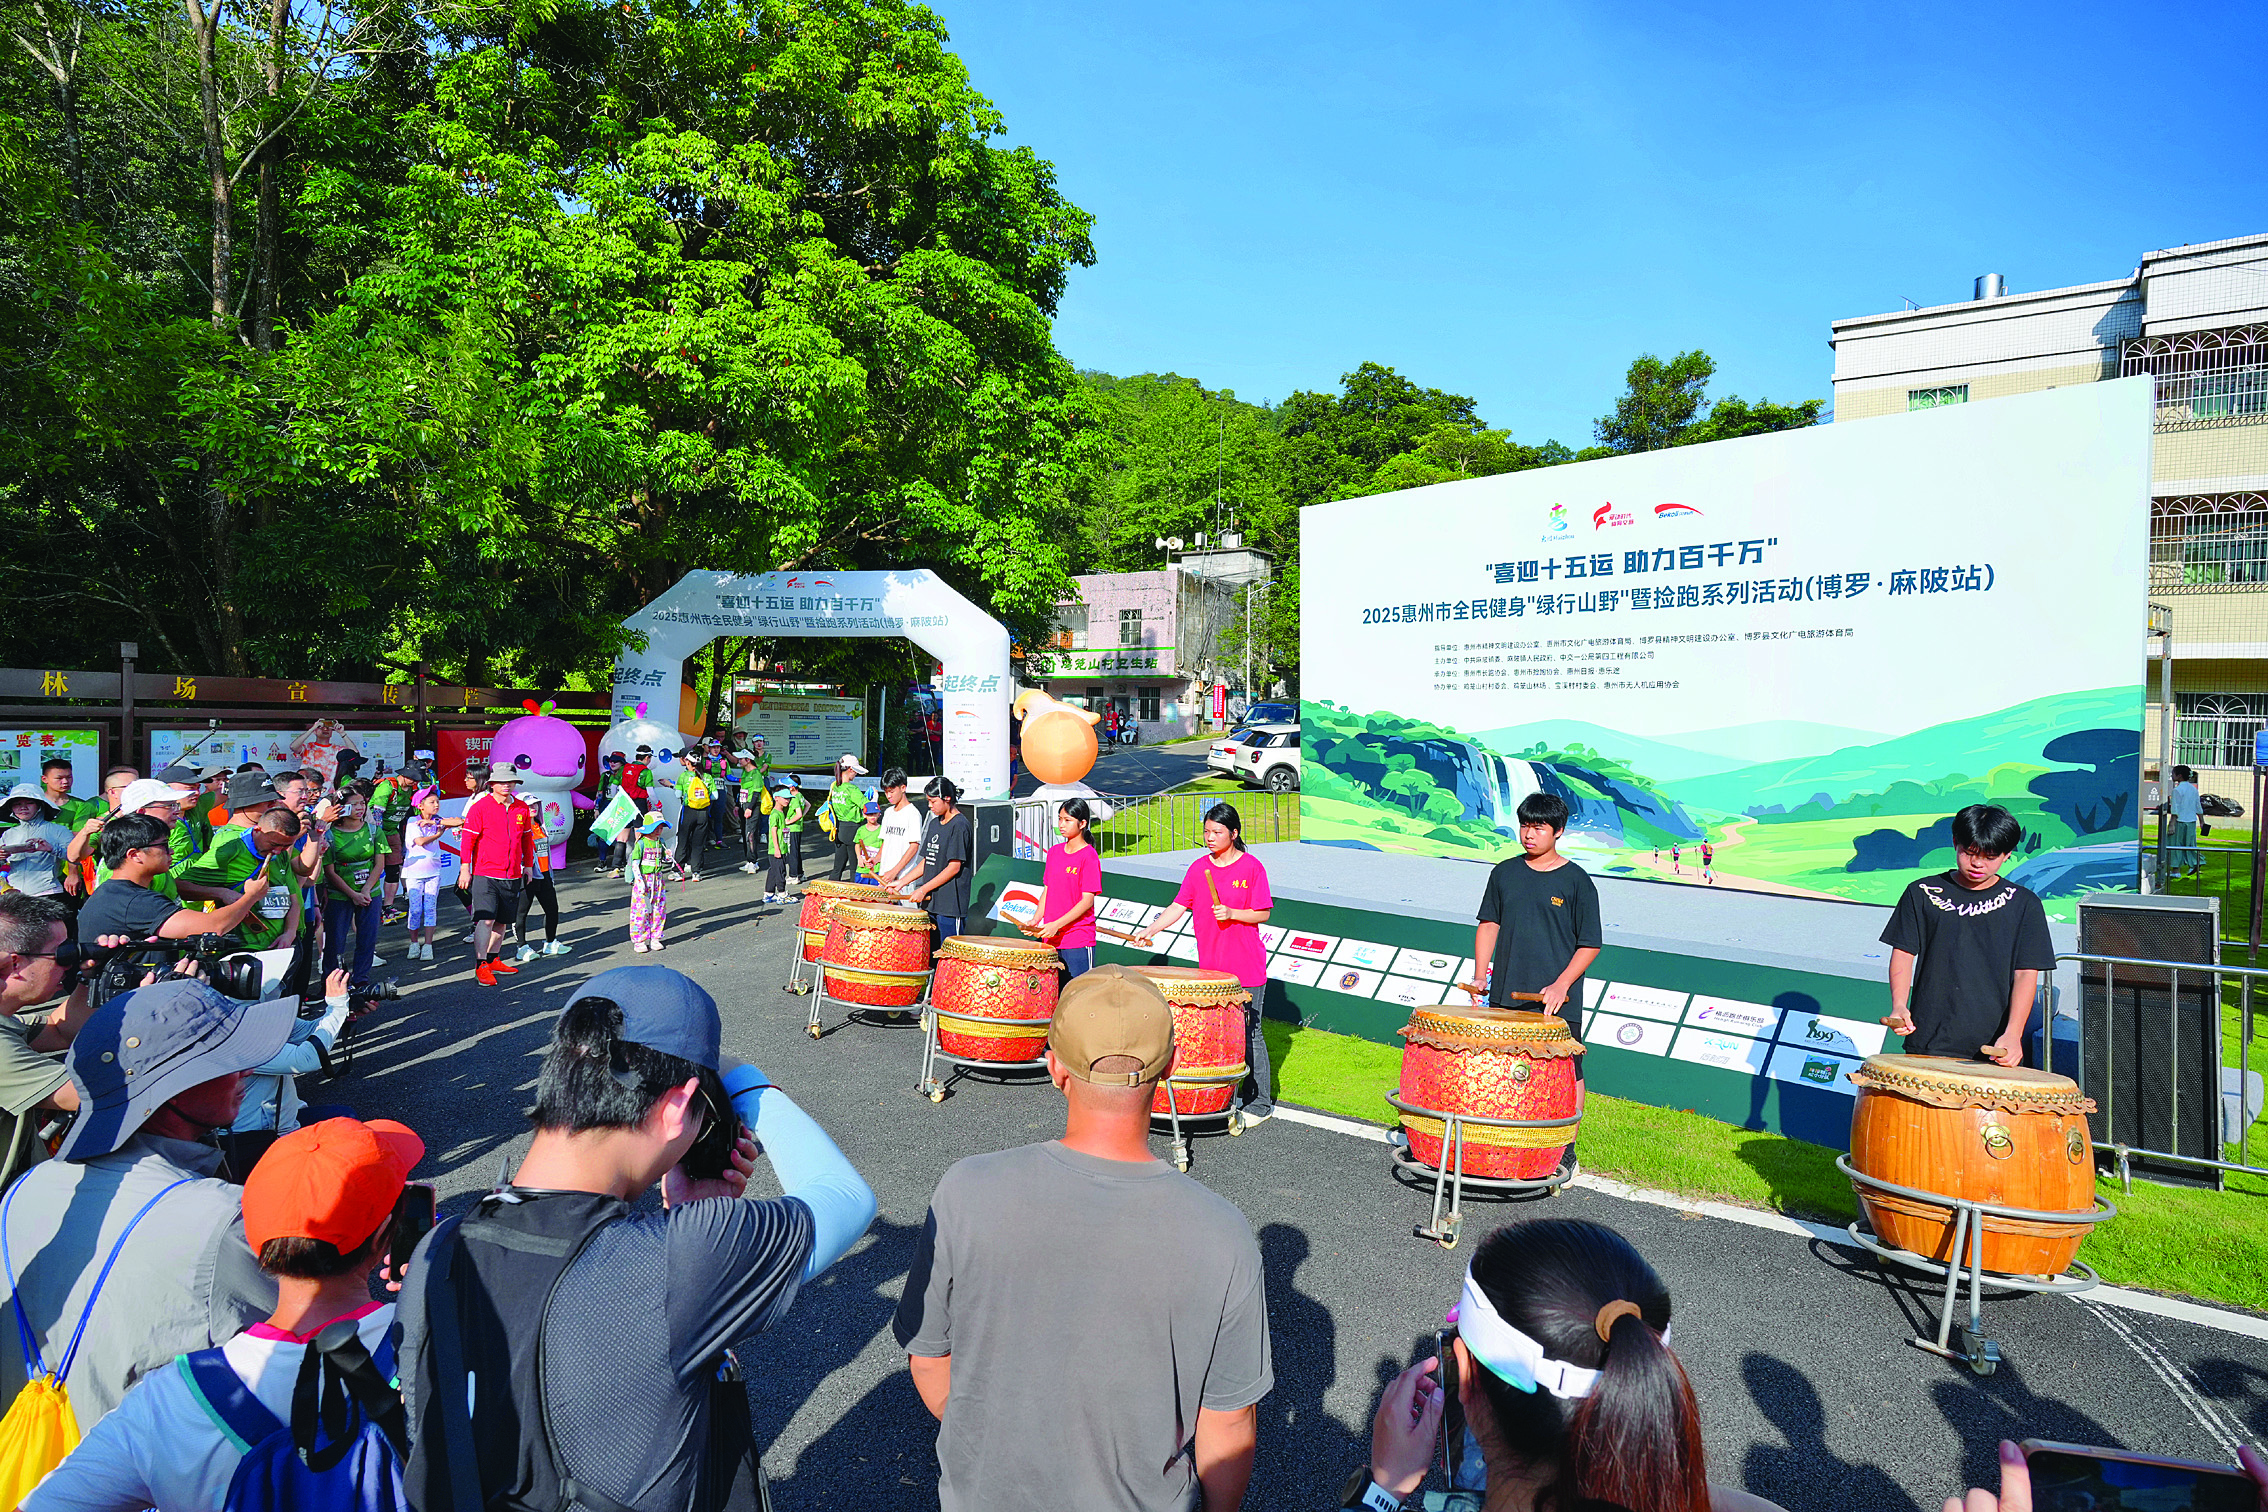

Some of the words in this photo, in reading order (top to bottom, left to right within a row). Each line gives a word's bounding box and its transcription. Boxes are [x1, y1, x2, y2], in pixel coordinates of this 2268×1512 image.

[1486, 552, 1614, 584] "喜迎十五运
[1623, 537, 1778, 574] 助力百千万"
[614, 667, 667, 687] 起终点
[943, 674, 1001, 693] 起终点
